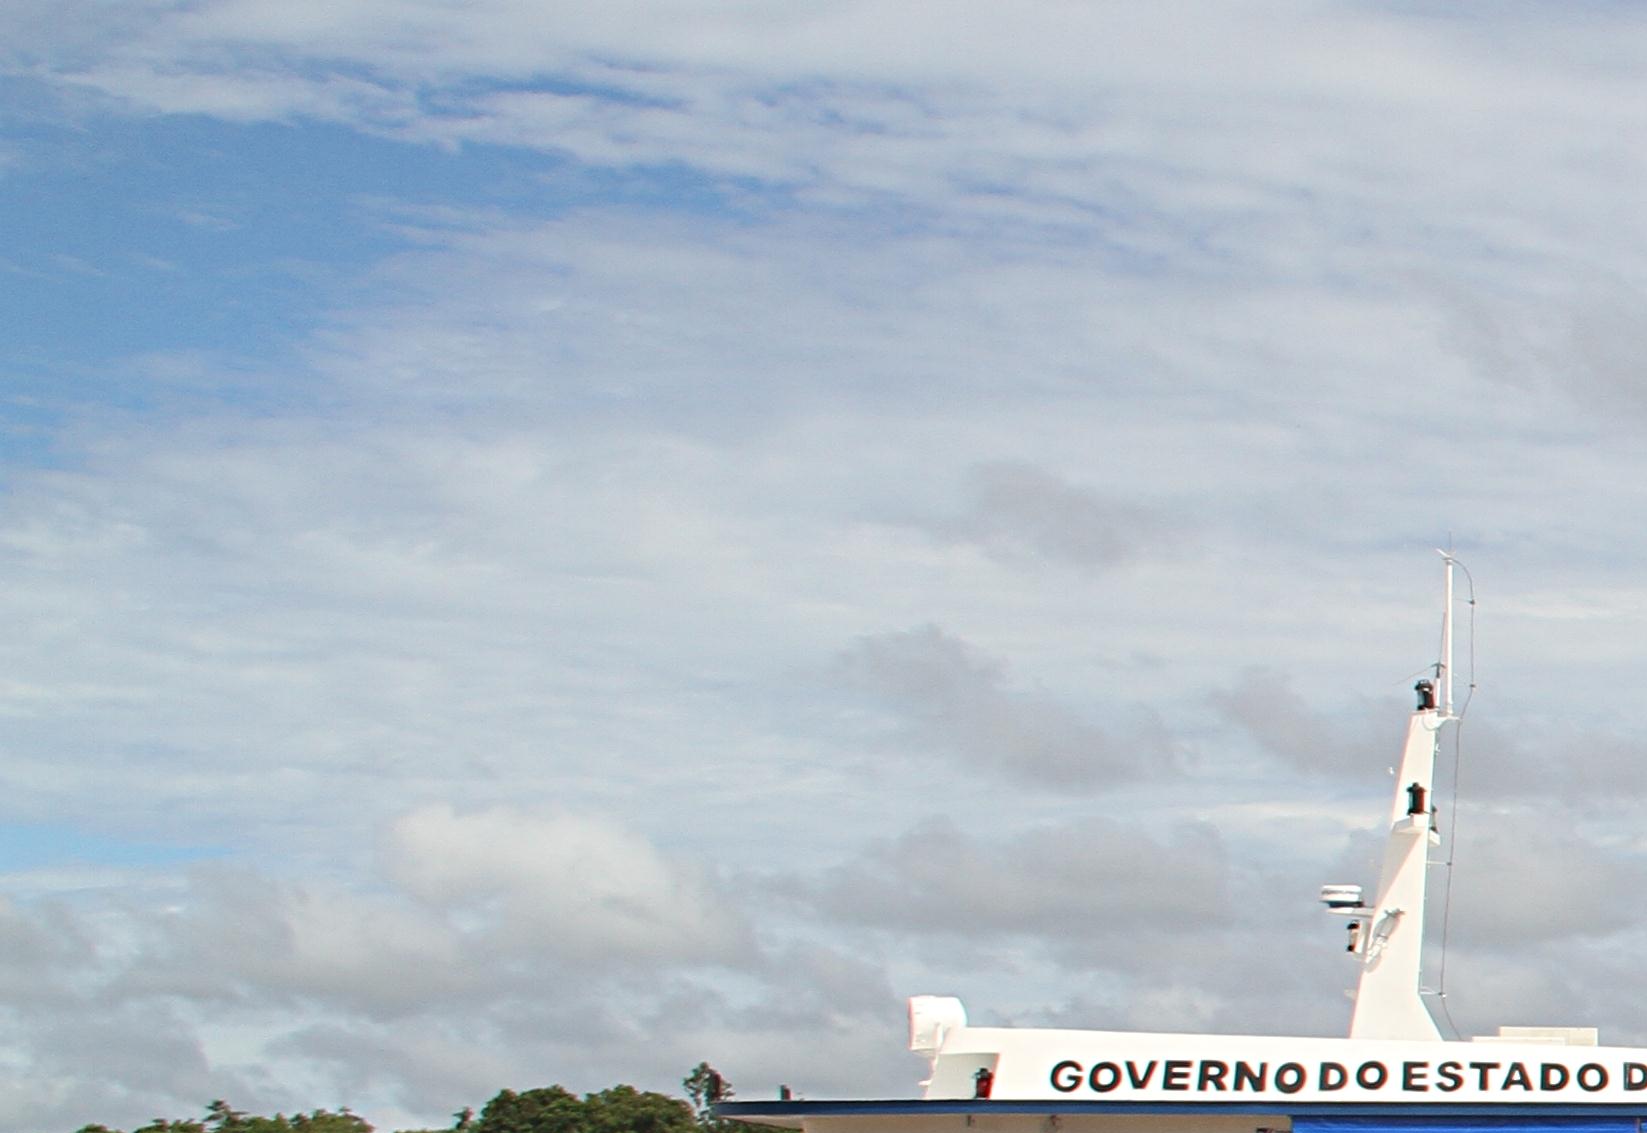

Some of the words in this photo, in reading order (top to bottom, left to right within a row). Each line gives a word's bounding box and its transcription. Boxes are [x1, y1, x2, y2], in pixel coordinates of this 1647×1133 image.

[1050, 1060, 1307, 1093] GOVERNO
[1317, 1061, 1389, 1092] DO
[1401, 1061, 1609, 1092] ESTADO
